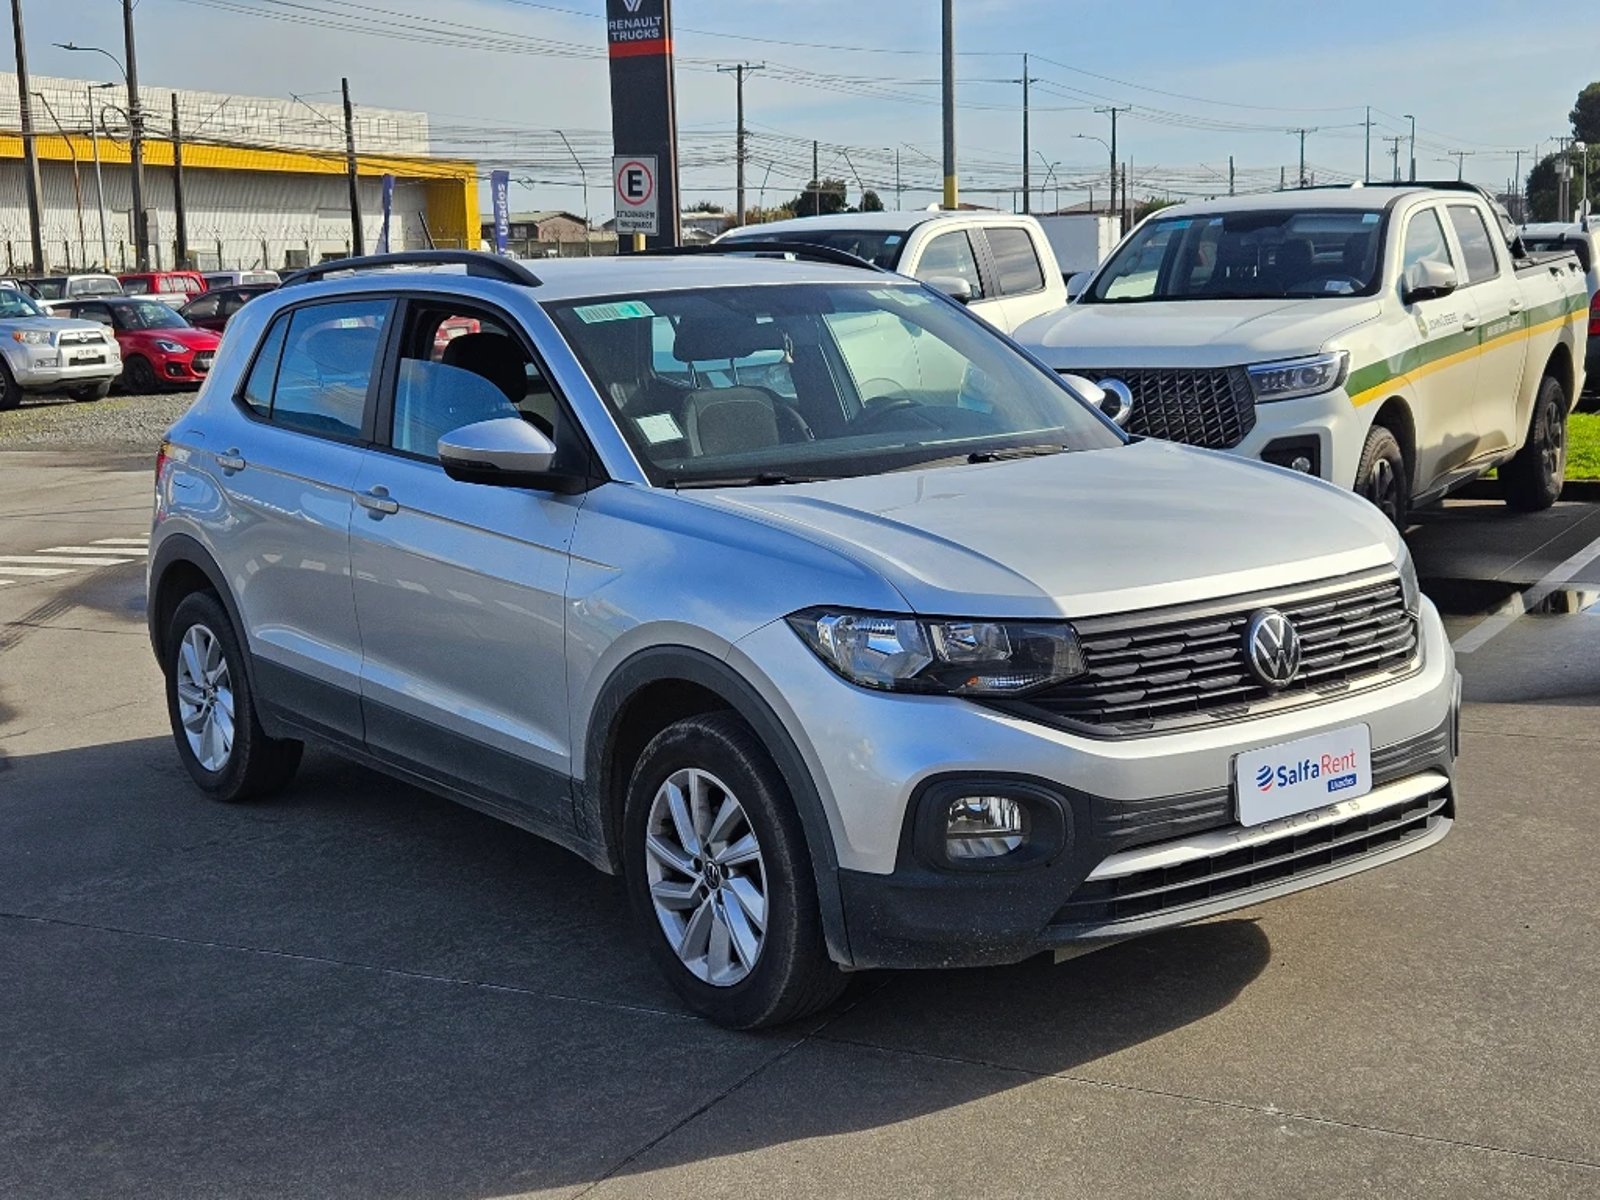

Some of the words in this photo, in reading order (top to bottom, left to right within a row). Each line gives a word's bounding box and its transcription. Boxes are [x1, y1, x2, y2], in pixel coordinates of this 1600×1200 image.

[608, 16, 662, 30] RENAULT
[611, 28, 659, 41] TRUCKS
[628, 170, 643, 197] E
[498, 183, 508, 236] Usados
[1277, 749, 1357, 787] SalfaRent
[1227, 800, 1360, 842] T-CROSS
